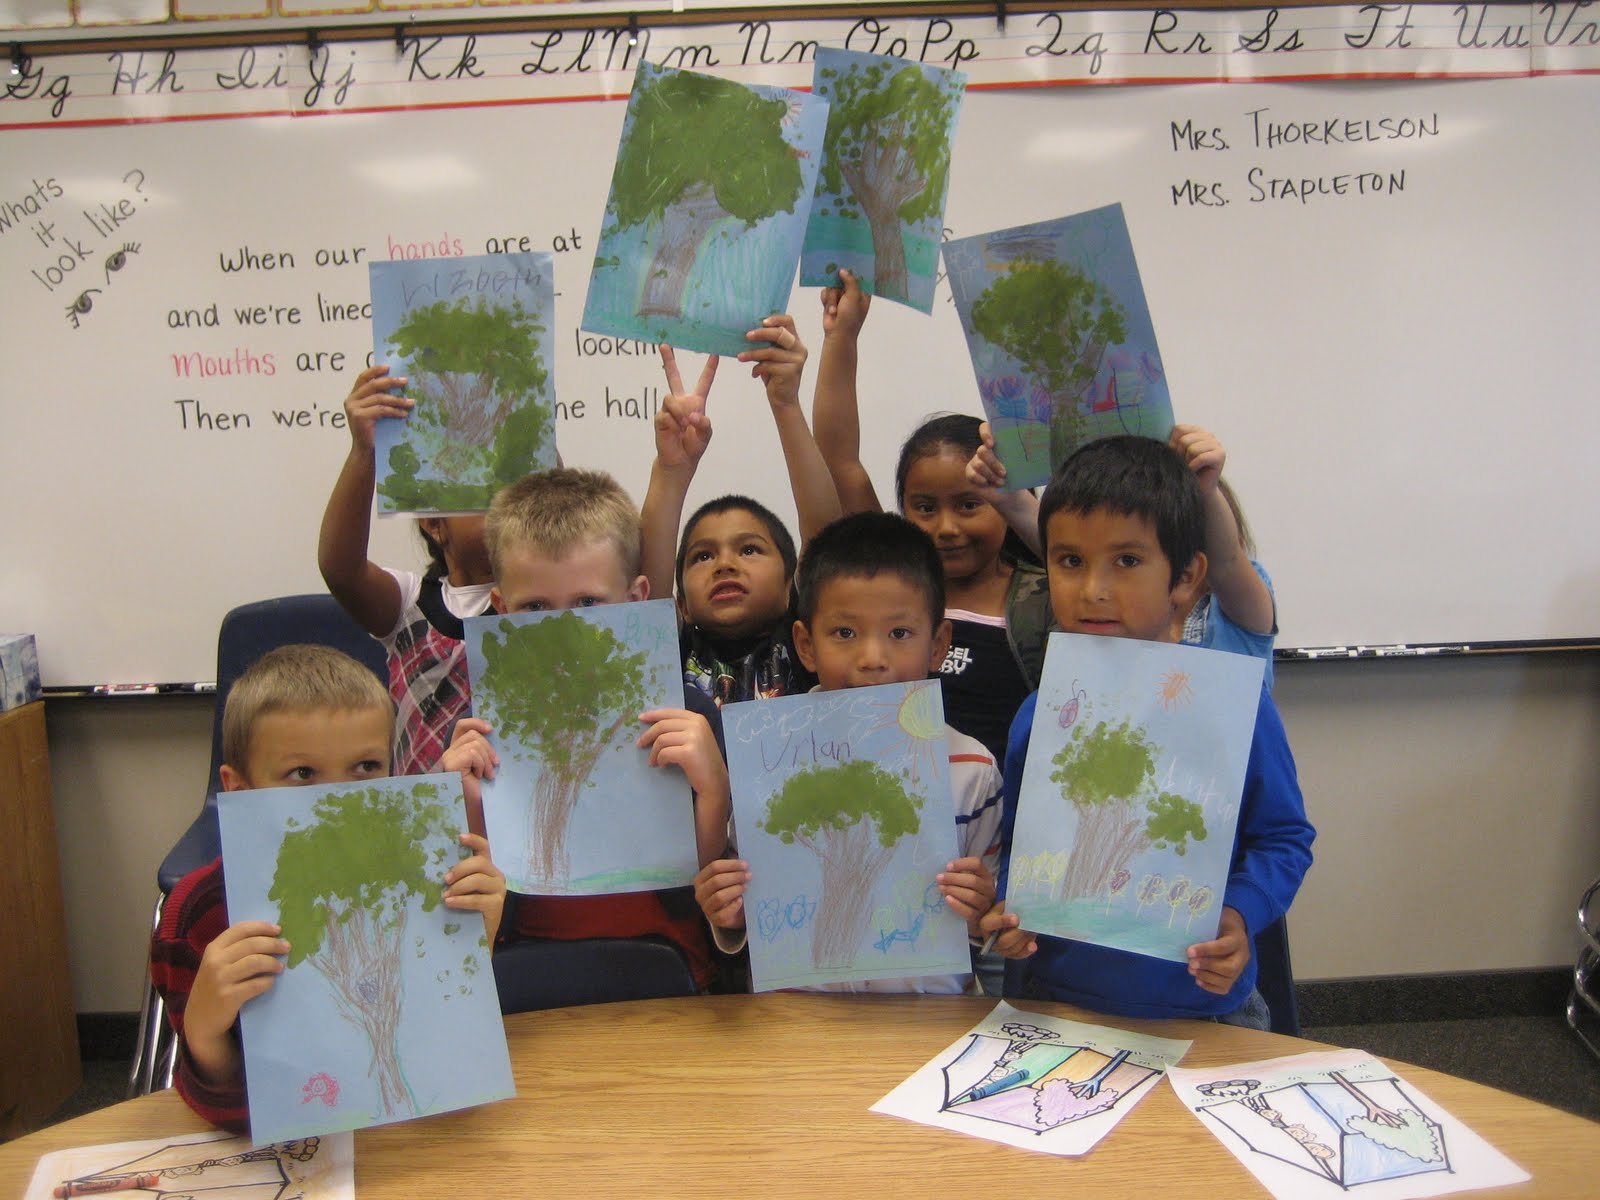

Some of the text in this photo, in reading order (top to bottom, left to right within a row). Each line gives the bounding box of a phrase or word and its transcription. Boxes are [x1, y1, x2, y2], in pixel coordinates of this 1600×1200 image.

[30, 220, 55, 248] it
[31, 168, 148, 292] look like?
[220, 228, 582, 272] When our hands are at
[168, 303, 220, 328] and
[234, 305, 301, 326] we're
[296, 351, 346, 372] are
[174, 400, 346, 430] Then we're
[605, 386, 658, 420] hall
